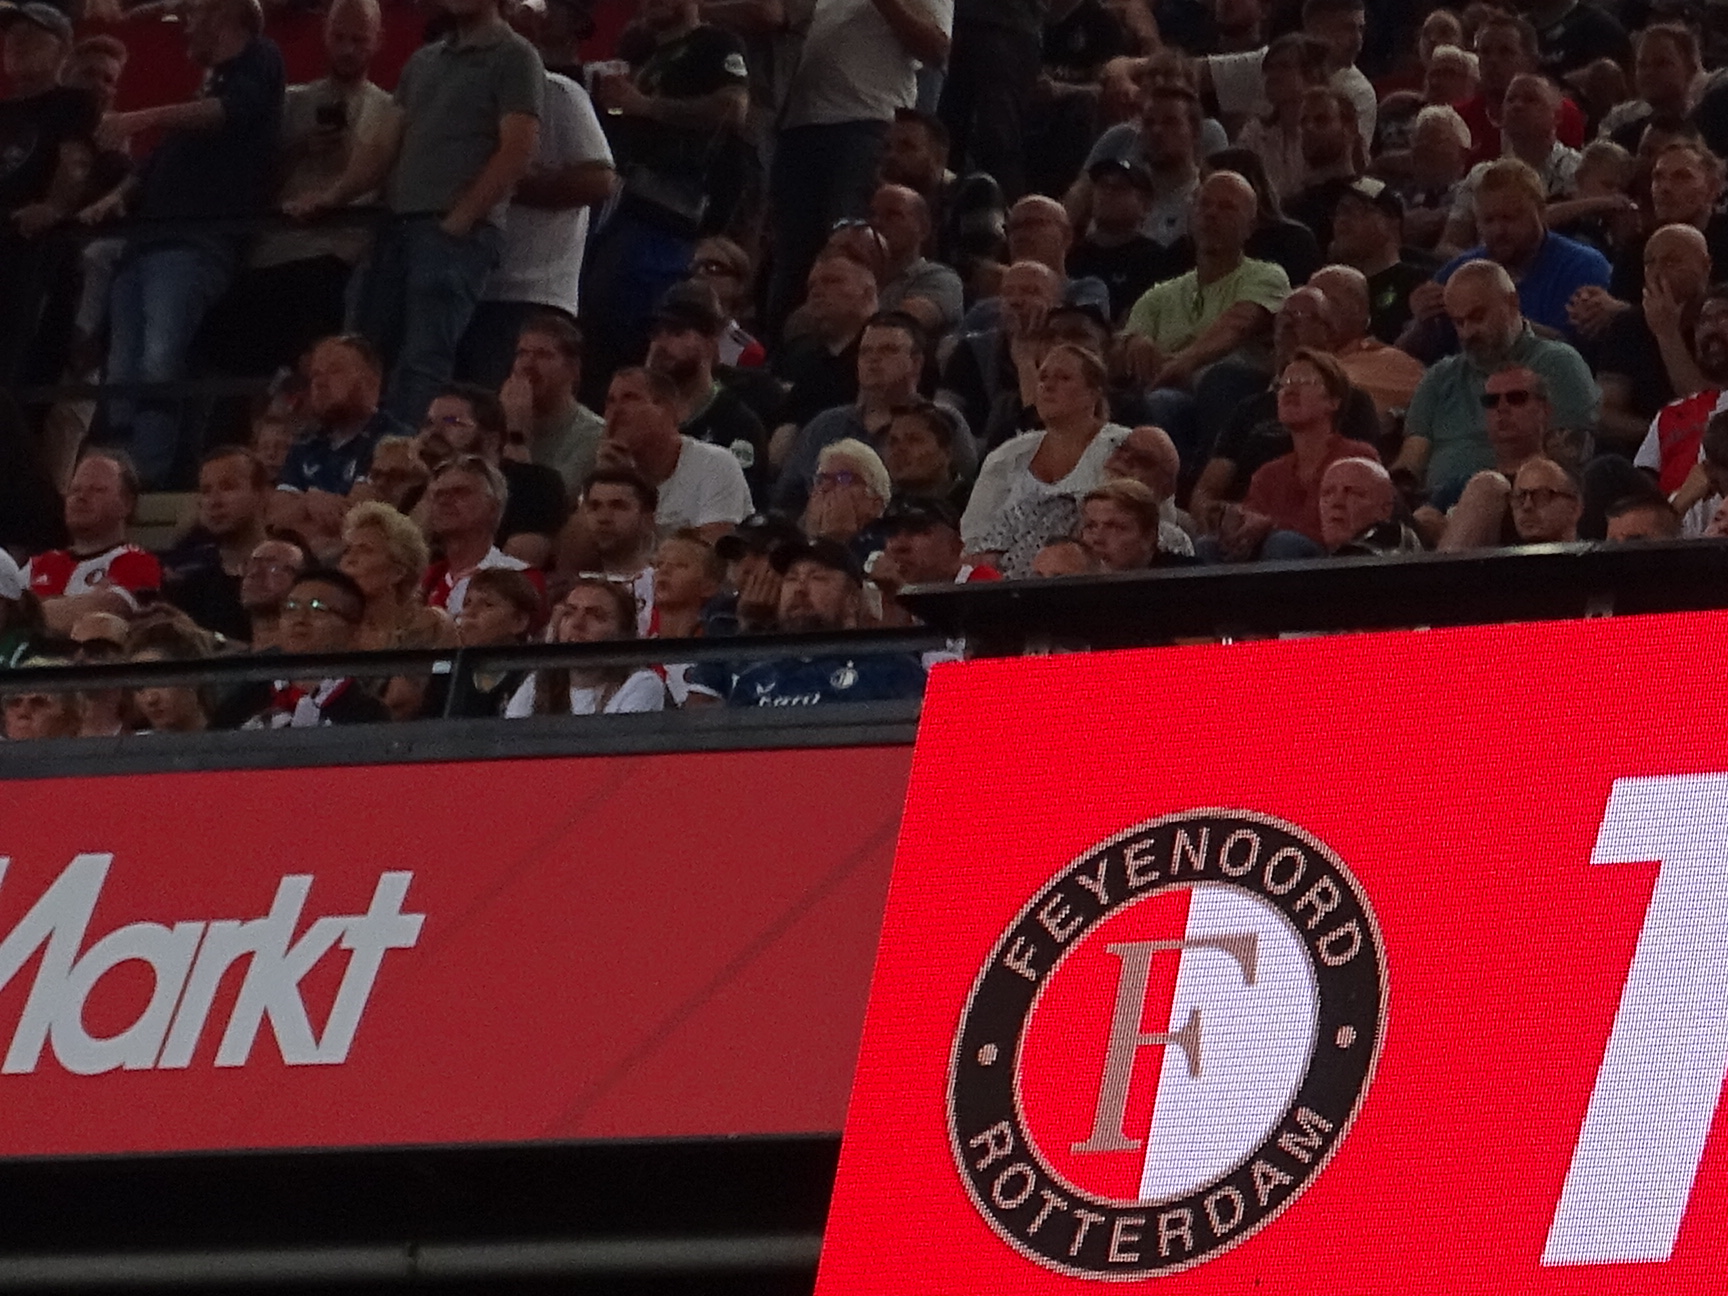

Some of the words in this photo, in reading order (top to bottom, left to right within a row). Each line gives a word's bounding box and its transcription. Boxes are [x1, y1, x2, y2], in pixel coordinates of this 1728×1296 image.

[1003, 827, 1363, 982] FEYENOORD
[1069, 932, 1258, 1154] F
[970, 1107, 1335, 1262] ROTTERDAM
